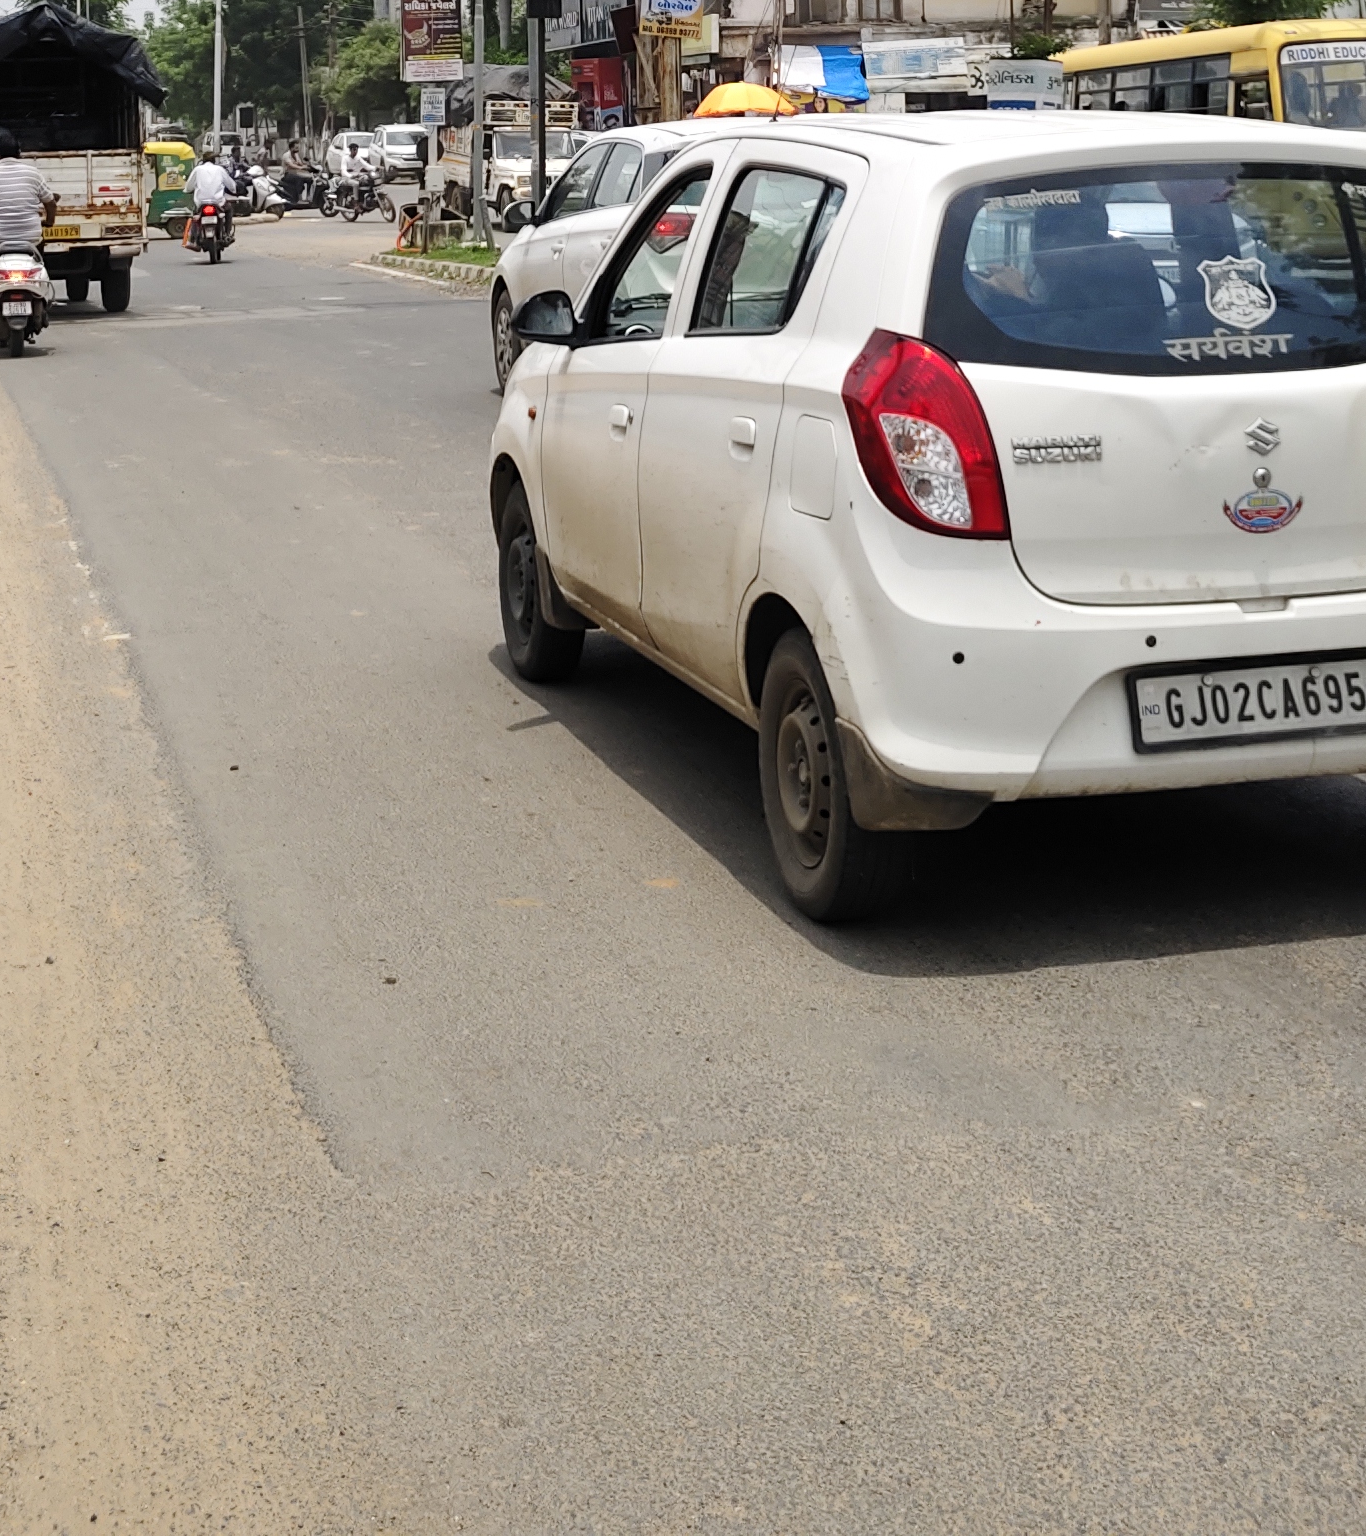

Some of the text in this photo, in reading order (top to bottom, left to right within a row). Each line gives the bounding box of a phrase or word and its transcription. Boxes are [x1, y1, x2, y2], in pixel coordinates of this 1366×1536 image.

[1287, 45, 1331, 62] RIDDHI
[1011, 434, 1102, 449] MARUTI
[1012, 445, 1102, 465] SUZUKI
[1141, 704, 1161, 716] IND
